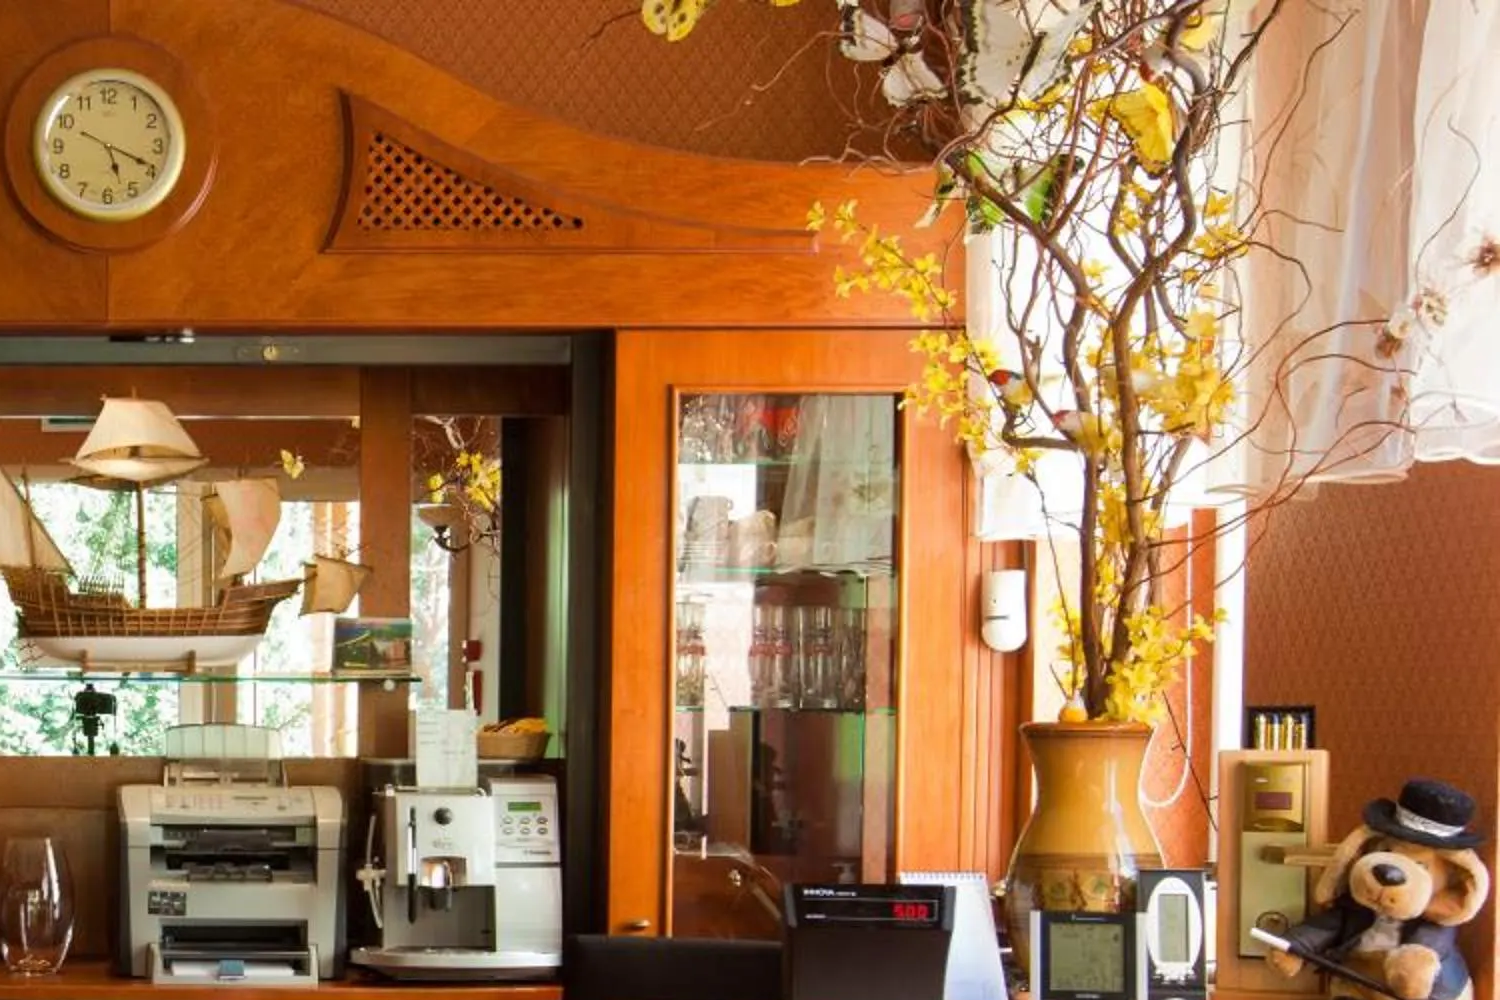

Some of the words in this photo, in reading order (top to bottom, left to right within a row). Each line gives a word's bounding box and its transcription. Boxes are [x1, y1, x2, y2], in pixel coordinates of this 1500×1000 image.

[77, 95, 91, 111] 11
[100, 87, 118, 105] 12
[131, 95, 138, 111] 1
[58, 114, 75, 129] 10
[145, 113, 157, 129] 2
[53, 138, 64, 154] 9
[152, 138, 164, 154] 3
[58, 163, 71, 179] 8
[145, 164, 156, 180] 4
[78, 182, 88, 198] 7
[102, 188, 114, 205] 6
[127, 181, 139, 197] 5
